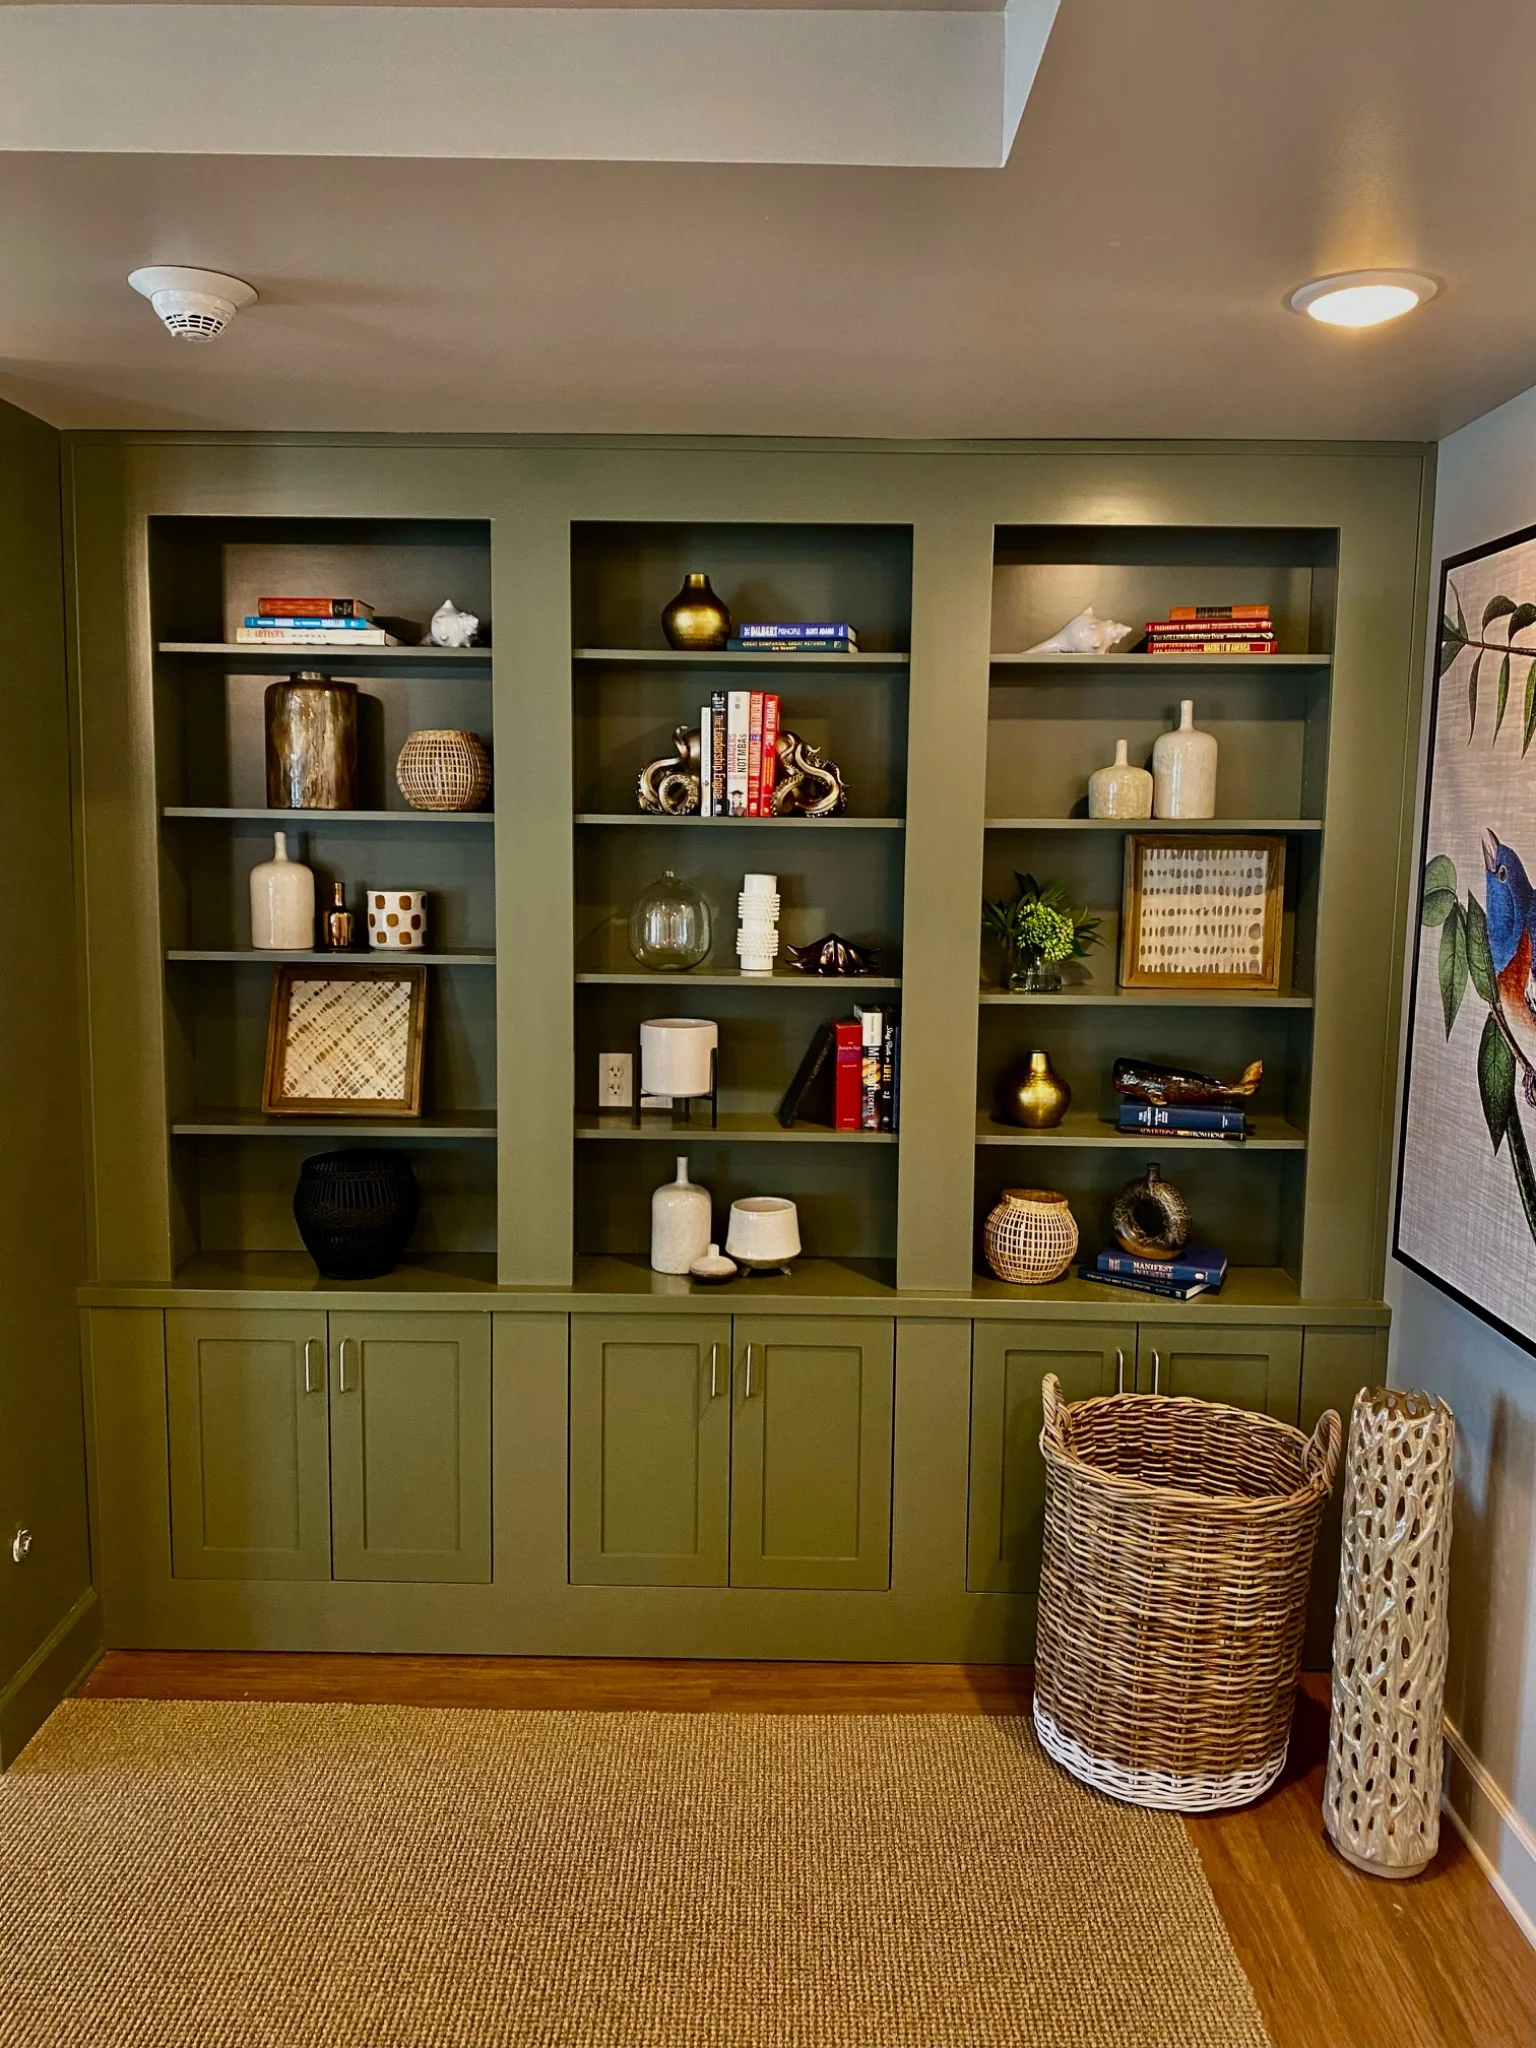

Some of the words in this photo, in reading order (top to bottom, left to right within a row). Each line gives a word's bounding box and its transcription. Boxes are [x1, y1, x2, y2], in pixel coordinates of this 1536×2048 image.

[751, 626, 778, 637] DILBERT
[766, 700, 777, 729] WORLD
[712, 726, 726, 772] Leadership
[737, 758, 747, 773] NOT
[712, 772, 726, 800] Engine
[867, 1047, 881, 1091] Microsoft
[883, 1064, 892, 1082] LIFE!
[1133, 1261, 1174, 1272] MANIFEST
[1133, 1269, 1173, 1279] INJUSTICE
